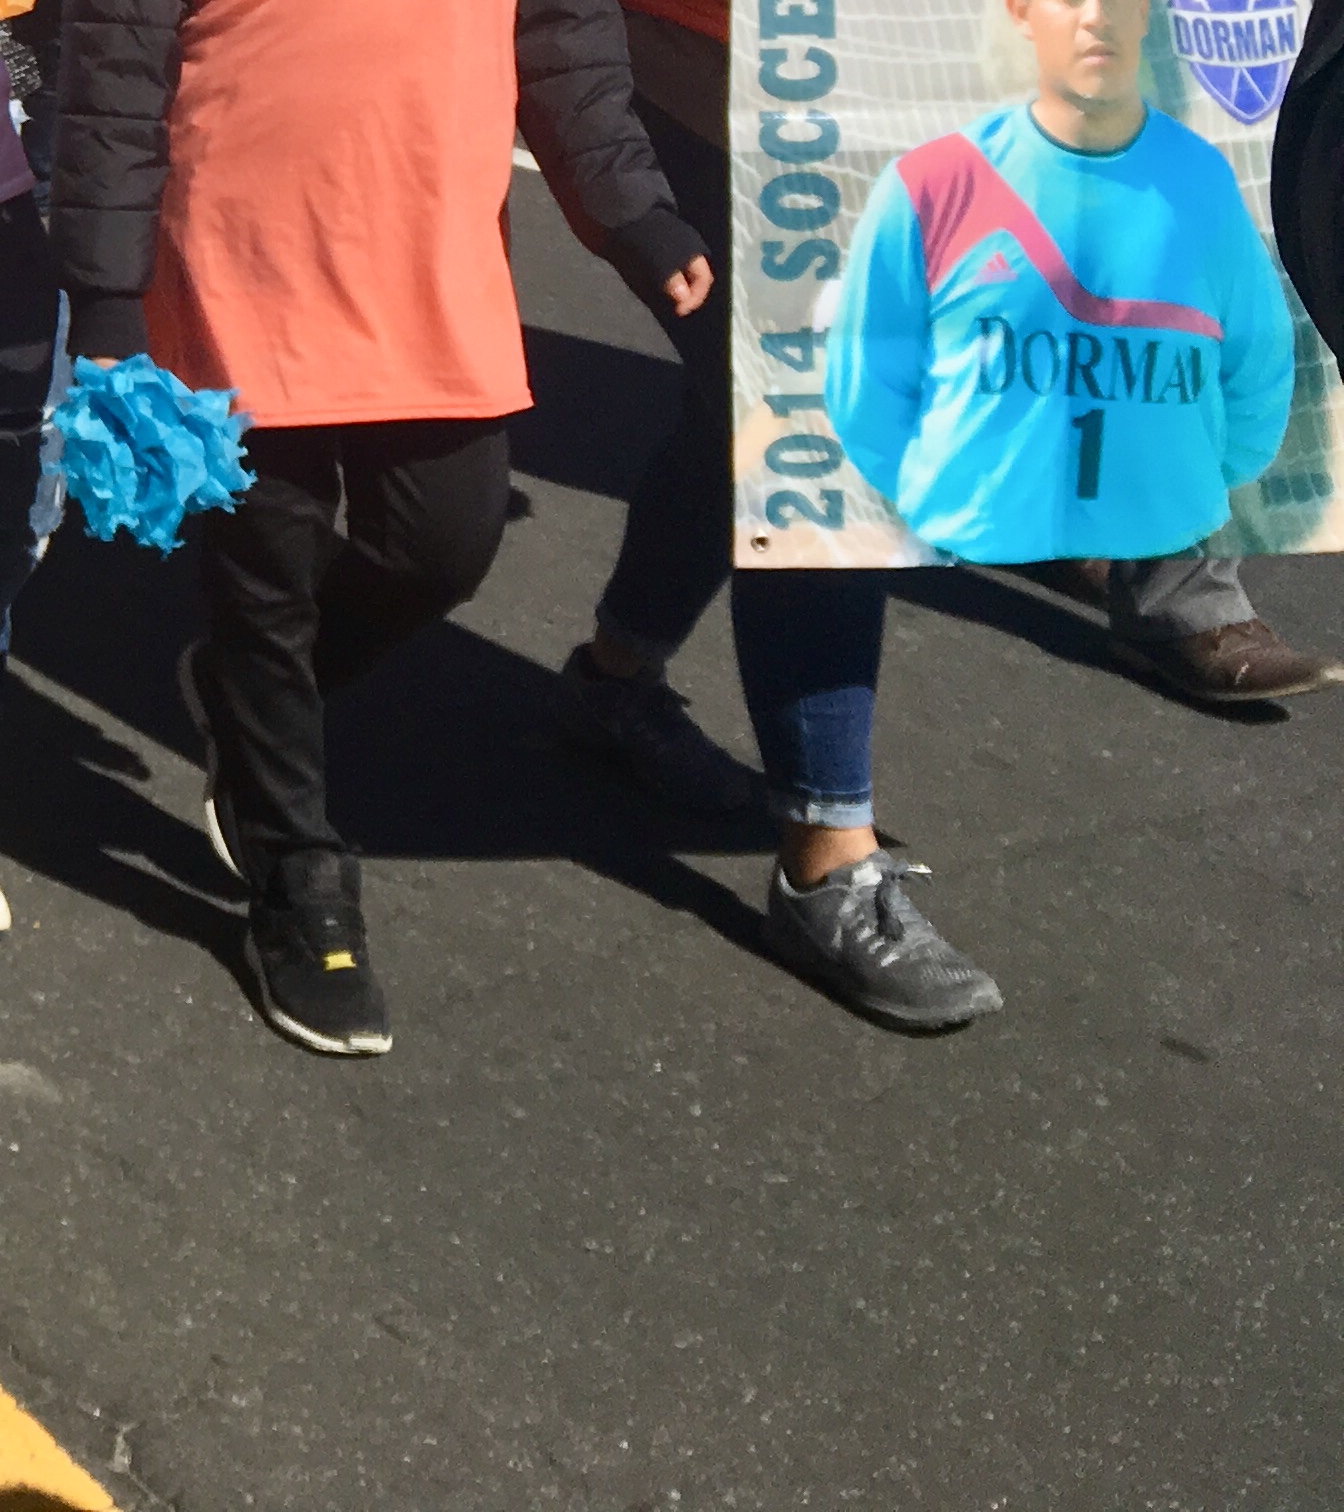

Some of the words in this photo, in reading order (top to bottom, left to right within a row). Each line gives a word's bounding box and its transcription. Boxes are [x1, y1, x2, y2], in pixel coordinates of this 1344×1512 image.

[1173, 13, 1296, 62] DORMAN
[761, 326, 846, 532] 2014
[1071, 408, 1105, 500] 1
